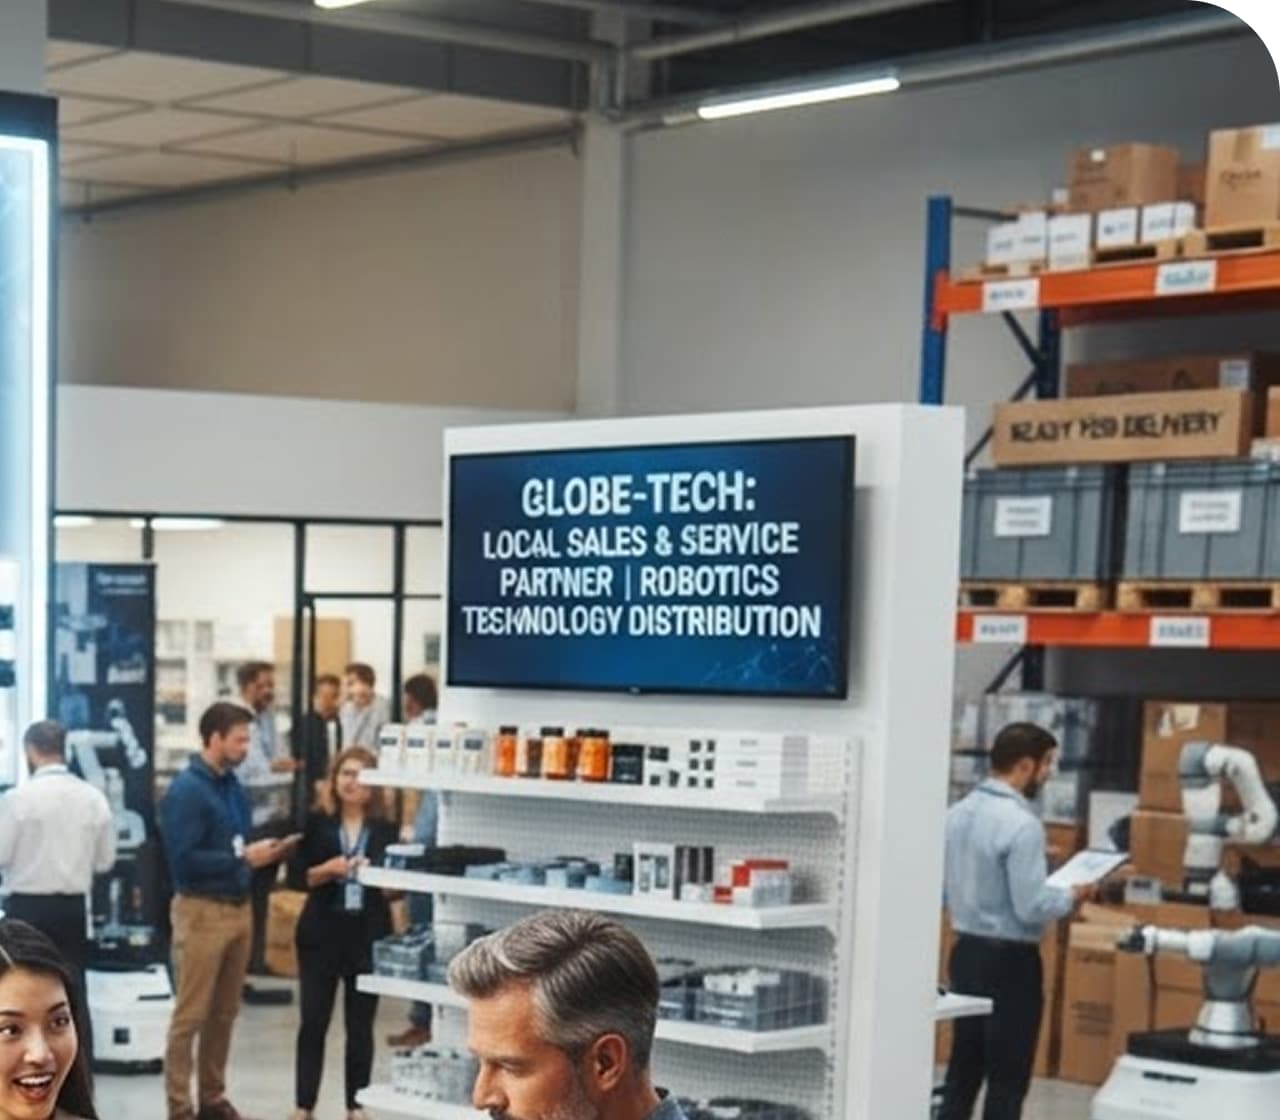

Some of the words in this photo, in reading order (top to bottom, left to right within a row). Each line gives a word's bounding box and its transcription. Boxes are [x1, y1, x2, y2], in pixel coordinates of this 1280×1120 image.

[521, 470, 758, 518] GLOBE-TECH:
[483, 529, 562, 560] LOCAL
[566, 525, 648, 558] SALES
[654, 525, 674, 557] &
[680, 522, 801, 556] SERVICE
[500, 566, 613, 597] PARTNER
[640, 563, 780, 597] ROBOTICS
[628, 605, 822, 638] DISTRIBUTION
